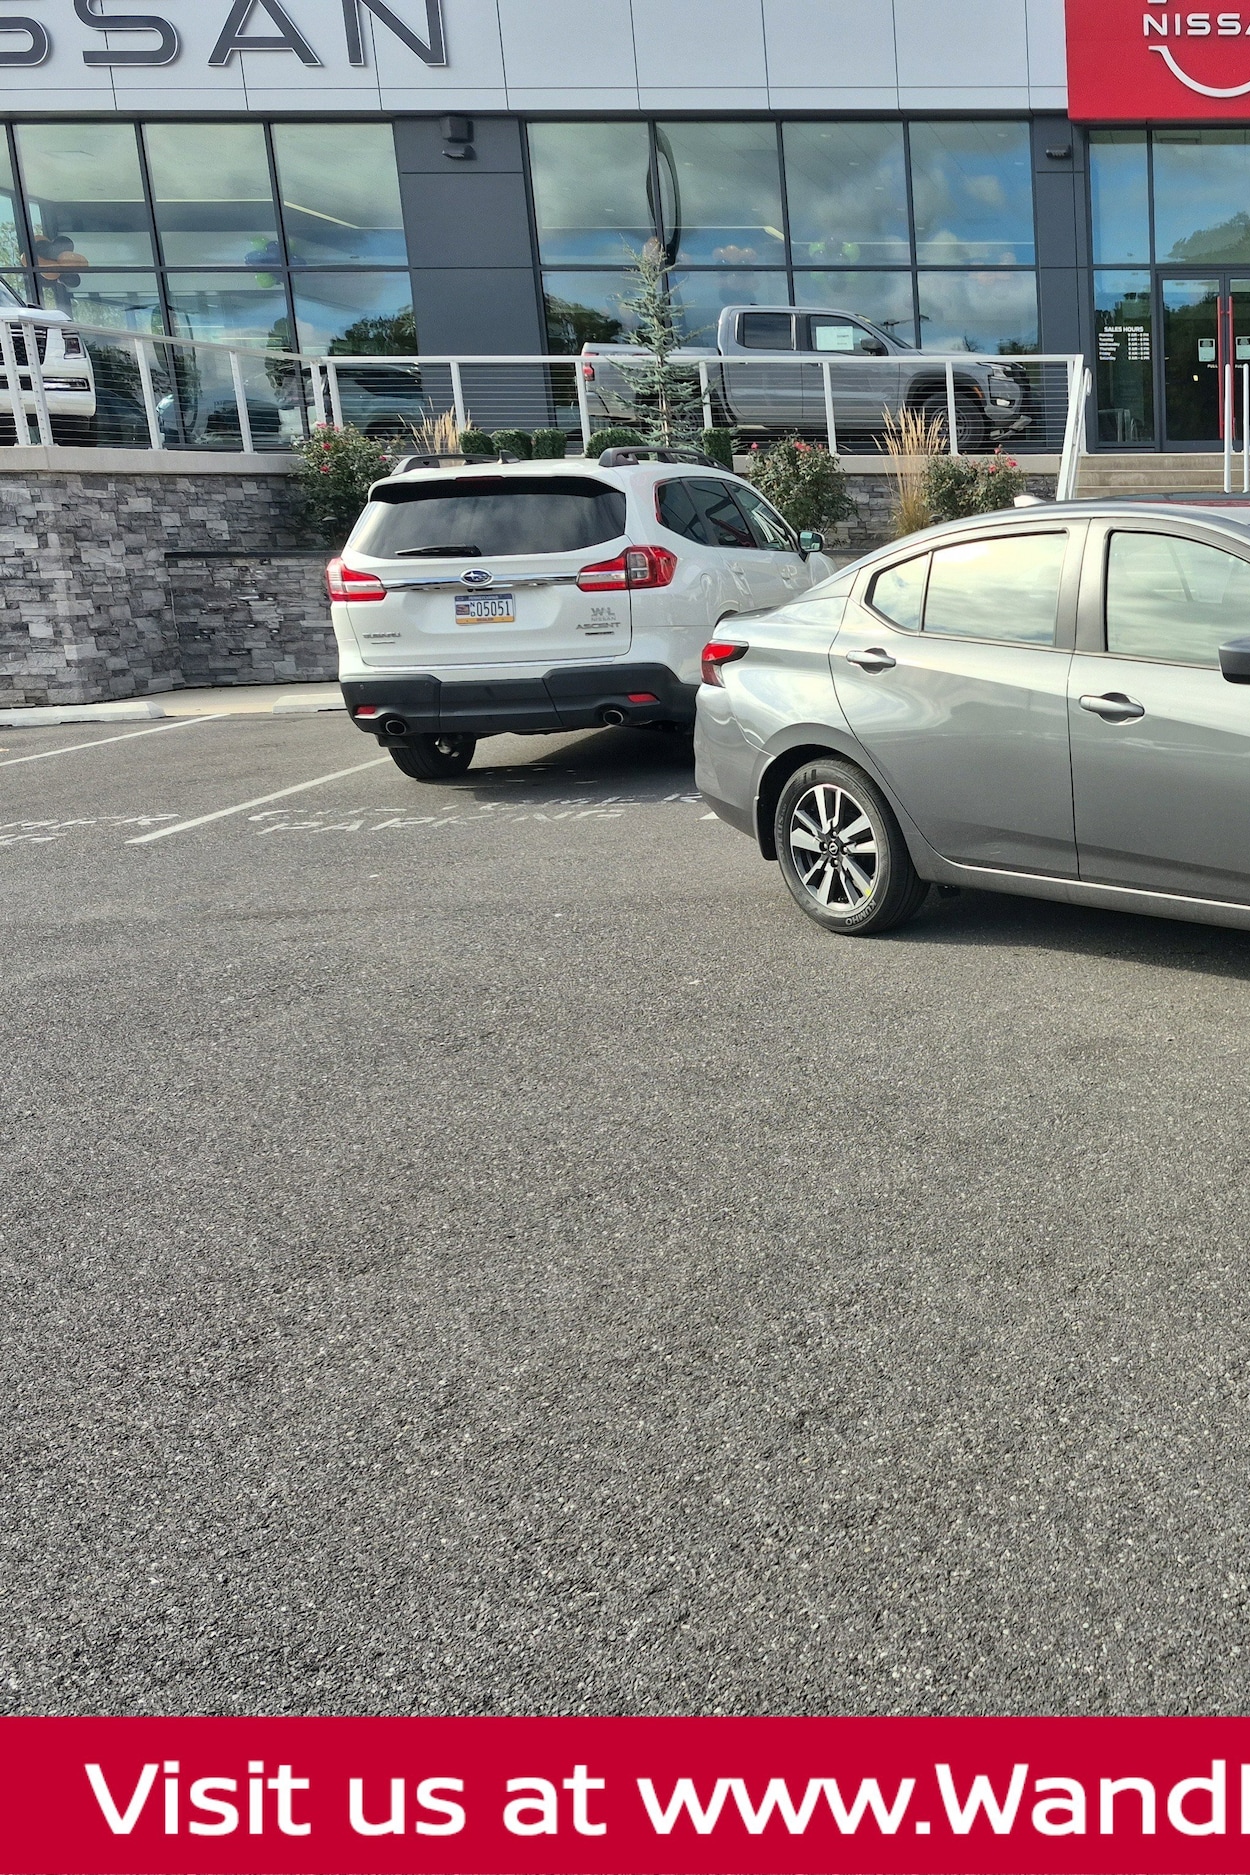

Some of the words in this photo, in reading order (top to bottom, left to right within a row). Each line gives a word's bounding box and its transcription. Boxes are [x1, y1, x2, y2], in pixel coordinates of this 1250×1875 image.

[476, 601, 511, 617] 05051
[575, 622, 621, 630] ASCENT
[844, 899, 877, 927] KUMHO
